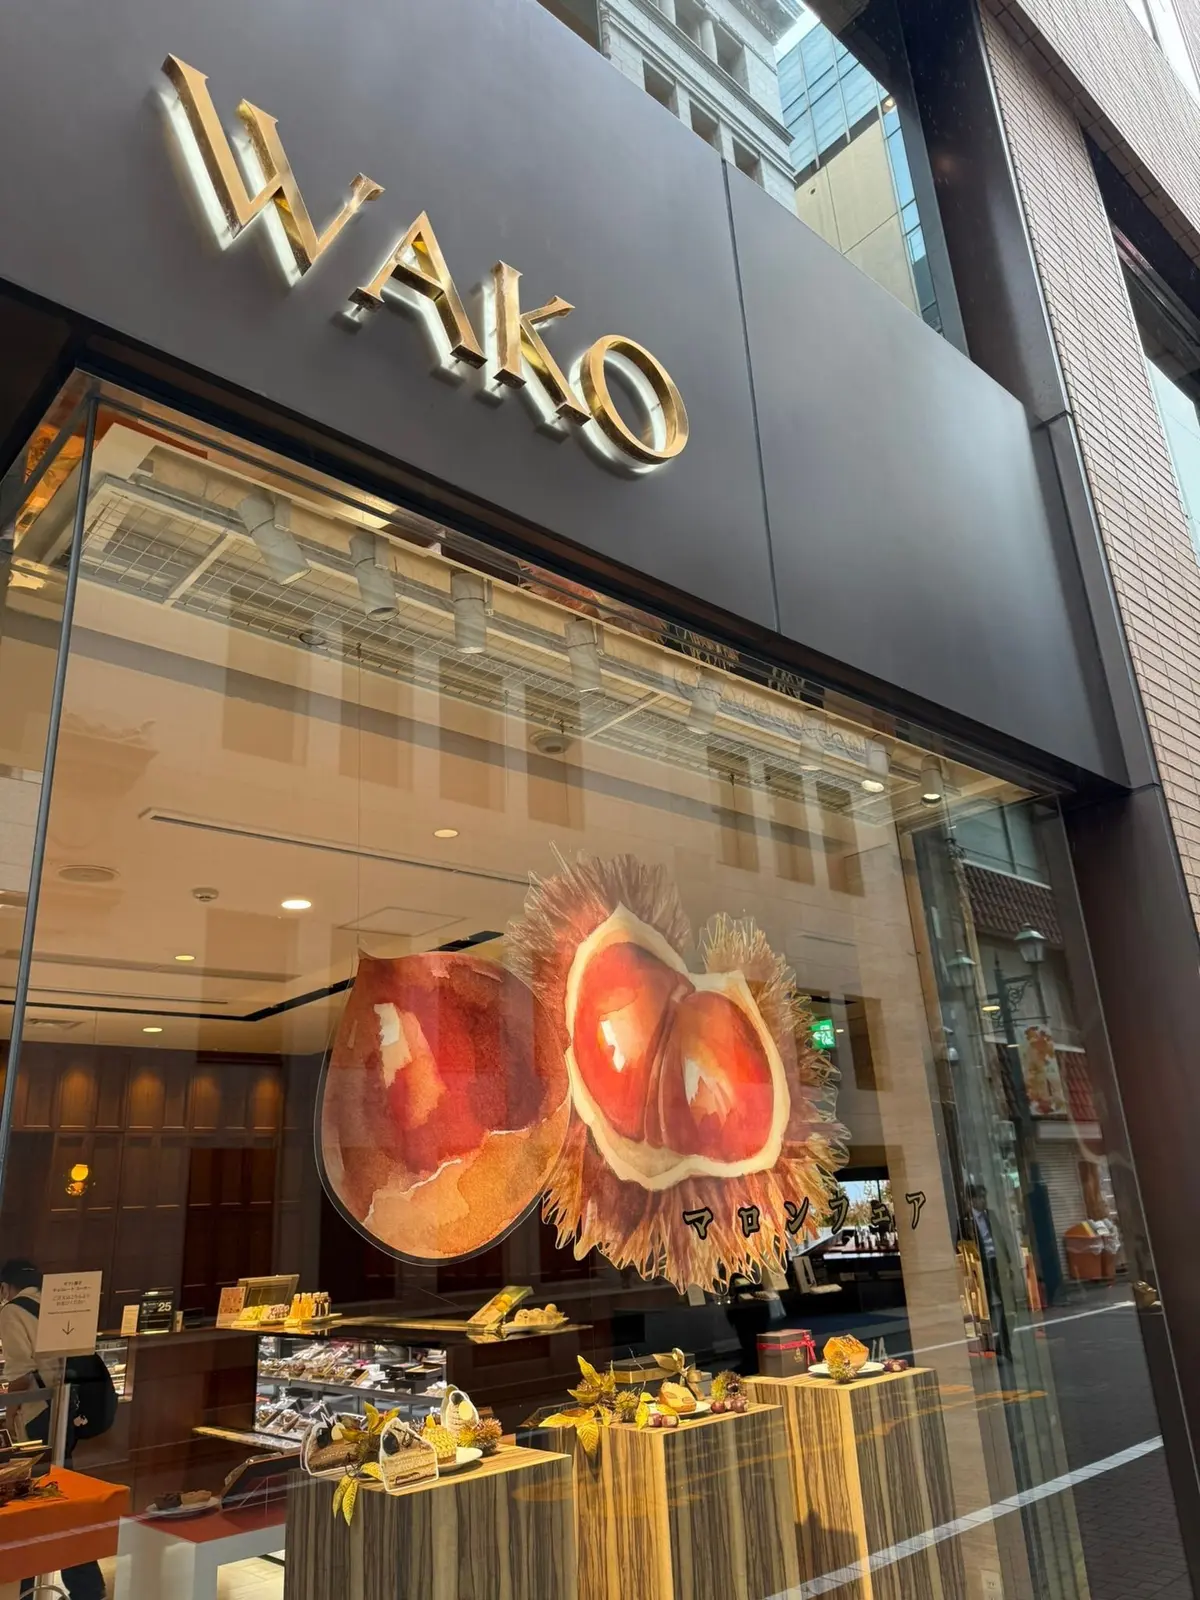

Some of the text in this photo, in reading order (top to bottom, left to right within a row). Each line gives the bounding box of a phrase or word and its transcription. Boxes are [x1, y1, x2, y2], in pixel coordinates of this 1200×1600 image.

[161, 53, 689, 465] WAKO
[683, 1191, 926, 1240] マロンフェア
[157, 1301, 172, 1312] 25
